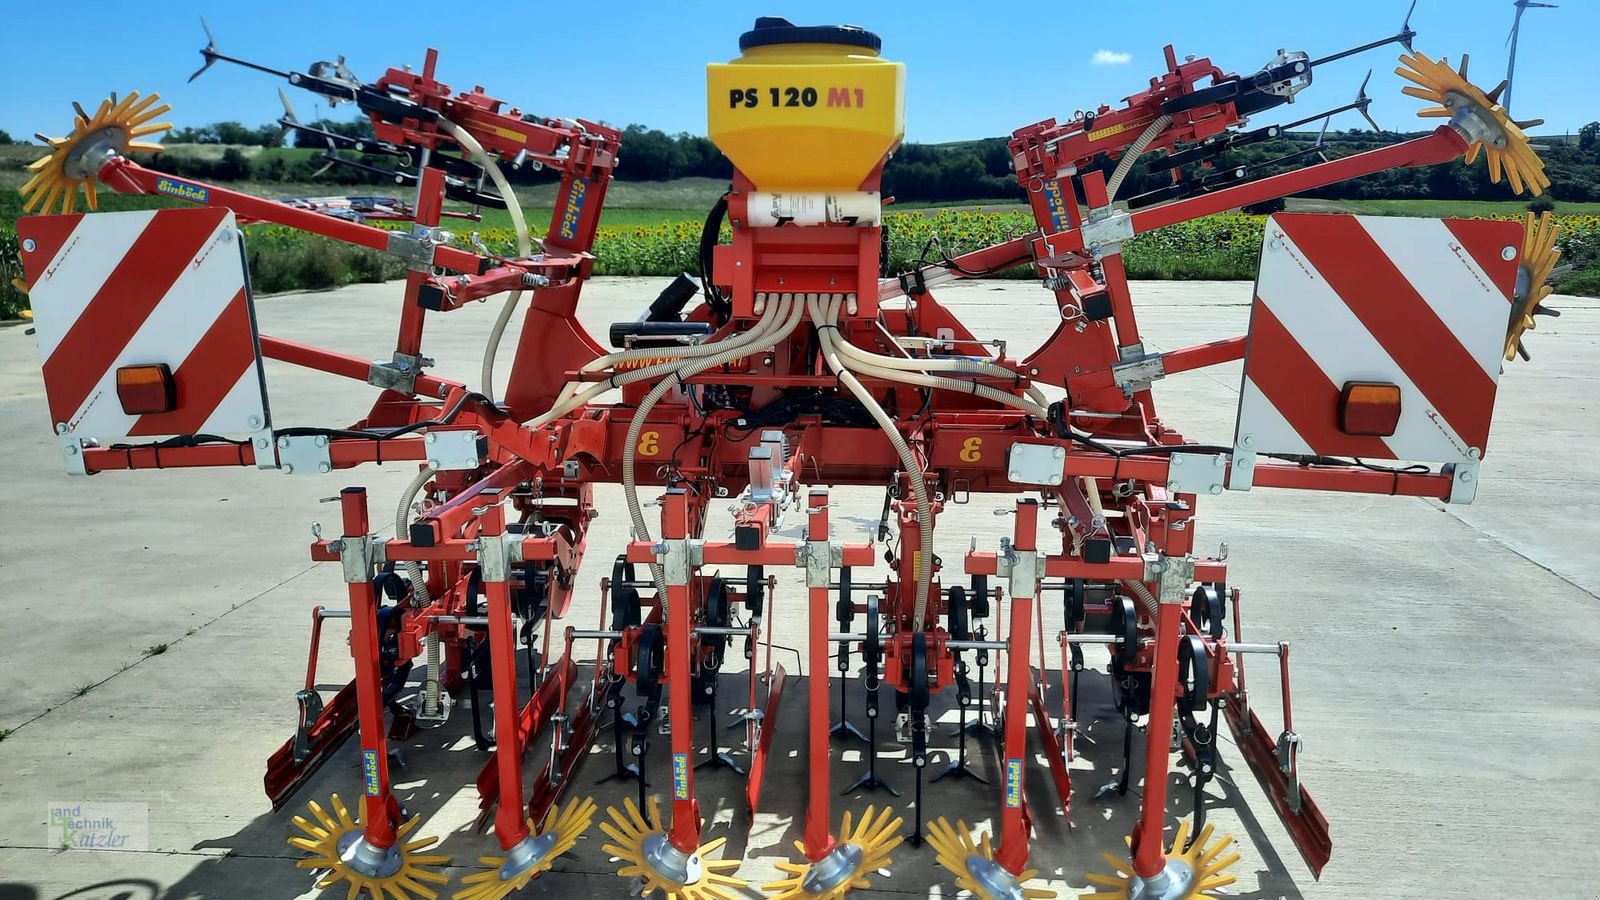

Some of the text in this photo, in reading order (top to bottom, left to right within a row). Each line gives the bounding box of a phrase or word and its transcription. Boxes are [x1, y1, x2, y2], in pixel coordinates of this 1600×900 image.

[729, 87, 864, 109] PS 120 M1
[158, 180, 206, 201] Einböck
[560, 179, 586, 239] Einböck
[1044, 181, 1069, 232] inböck
[364, 752, 378, 795] Einböck
[674, 755, 687, 799] Einböck
[1007, 761, 1020, 807] Einböck
